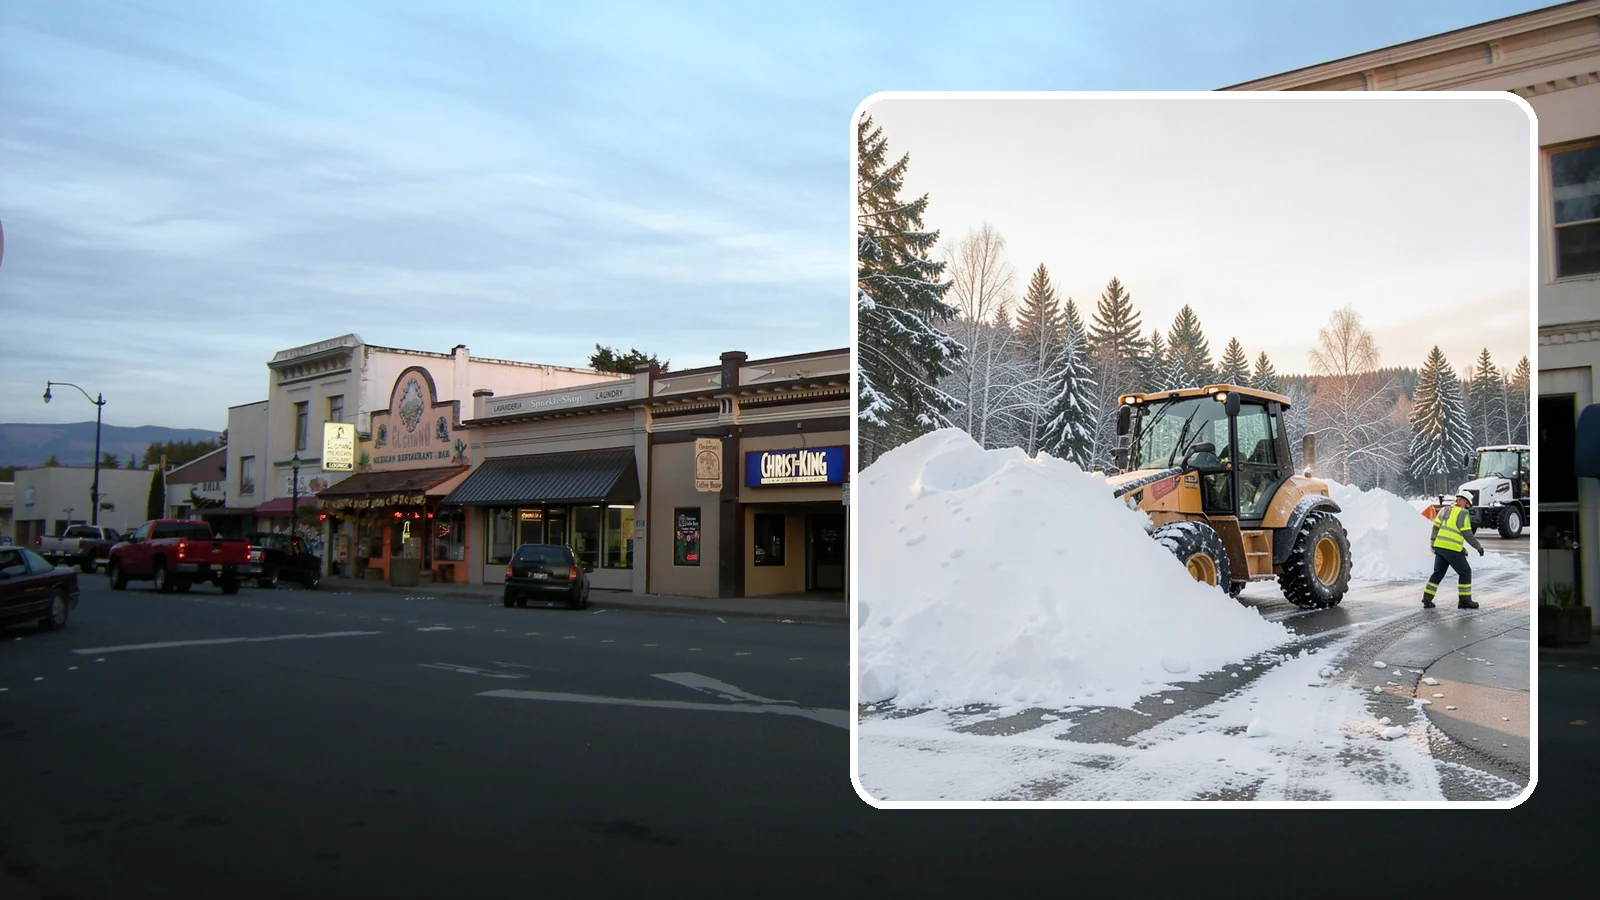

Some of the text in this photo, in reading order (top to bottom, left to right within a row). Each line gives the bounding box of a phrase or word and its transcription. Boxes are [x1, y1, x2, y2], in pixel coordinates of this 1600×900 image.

[493, 389, 624, 413] LAVANDERIA Sparkle Shop LAUNDRY
[373, 450, 450, 464] MEXICAN RESTAURANT BAR
[761, 450, 827, 477] CHRIST KING
